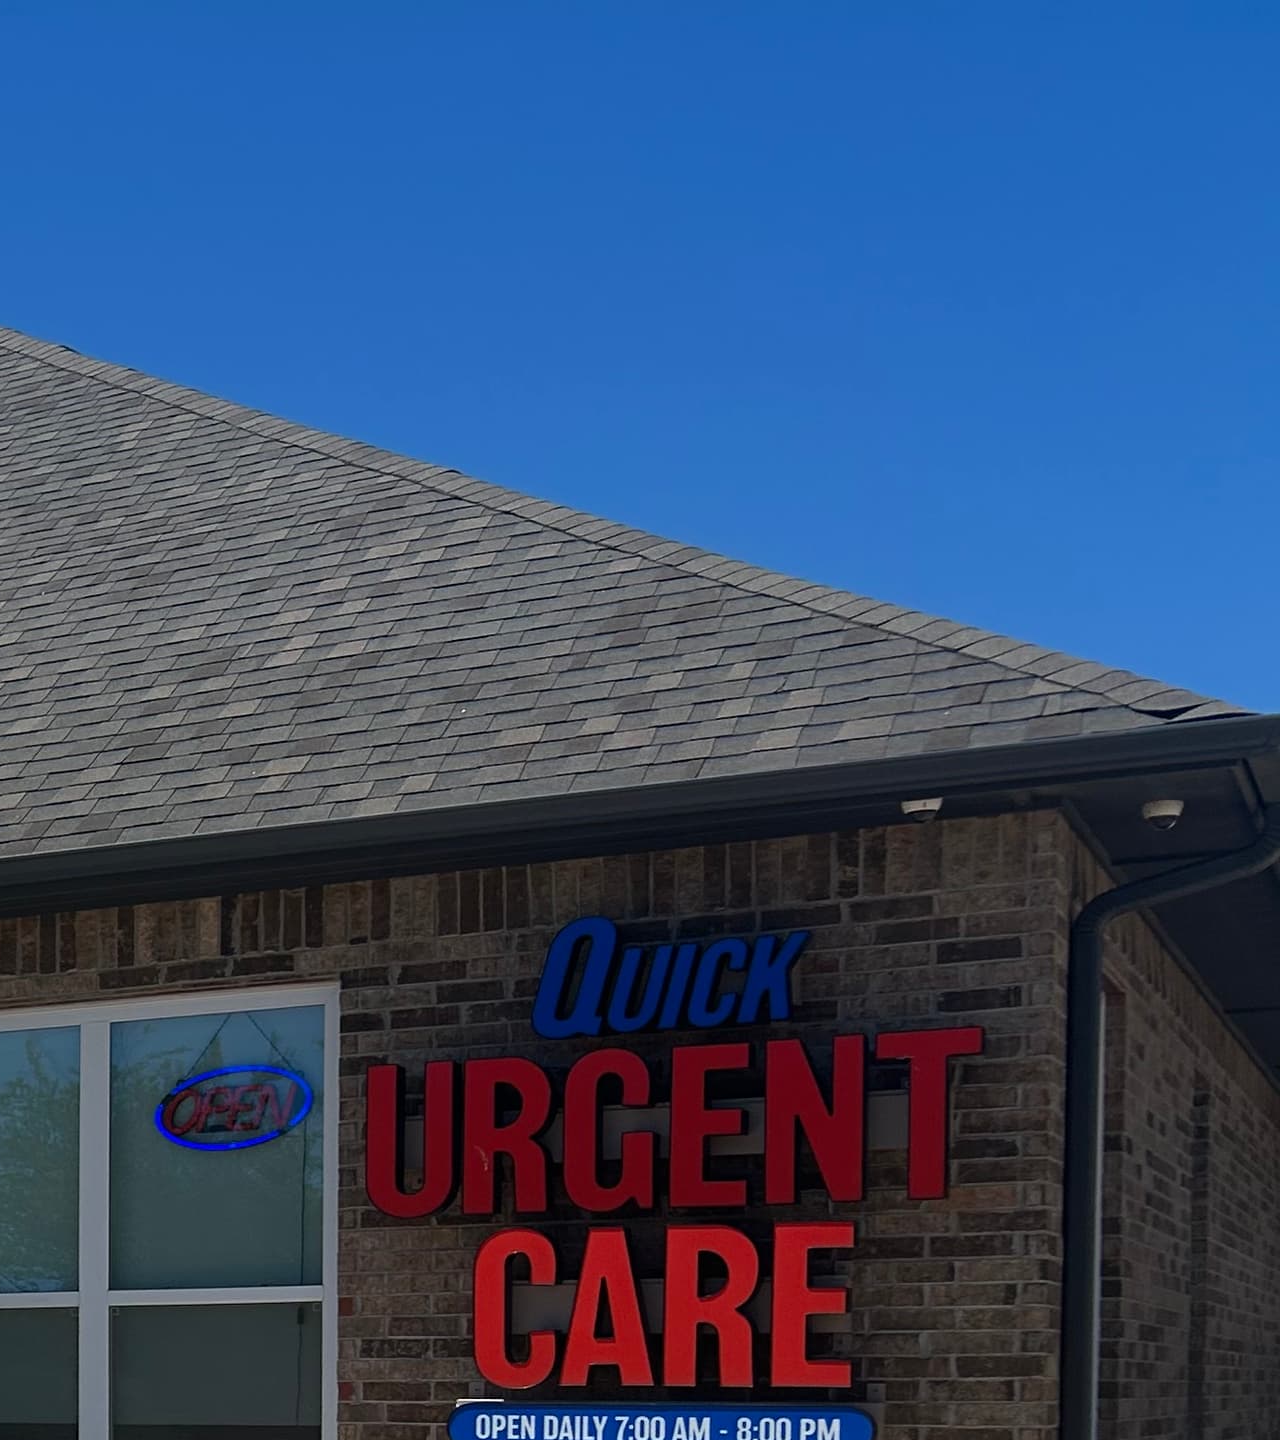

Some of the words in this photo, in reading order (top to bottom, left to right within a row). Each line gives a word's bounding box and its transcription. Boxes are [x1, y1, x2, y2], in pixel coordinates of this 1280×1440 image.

[531, 915, 810, 1039] QUICK
[164, 1083, 297, 1136] OPEN
[366, 1026, 983, 1217] URGENT
[473, 1222, 855, 1389] CARE
[475, 1414, 536, 1440] OPEN
[543, 1415, 608, 1440] DAILY
